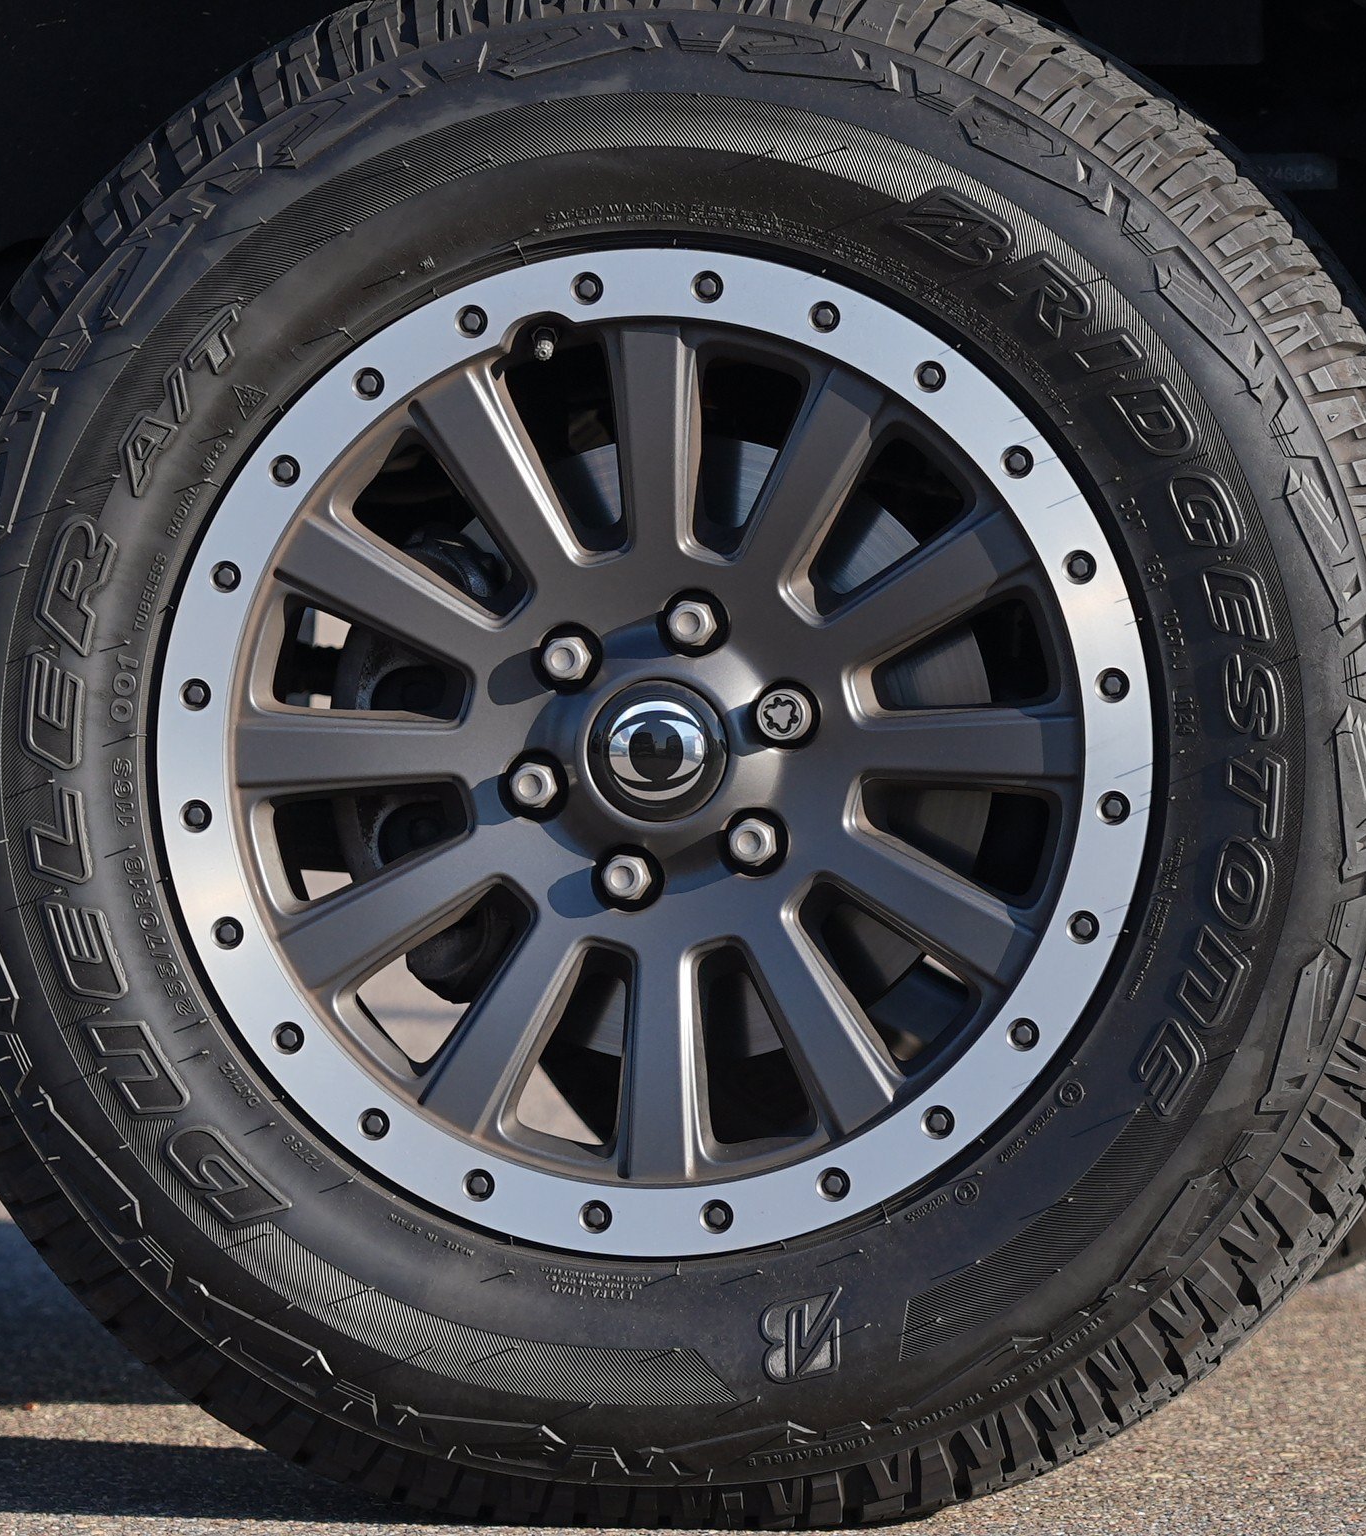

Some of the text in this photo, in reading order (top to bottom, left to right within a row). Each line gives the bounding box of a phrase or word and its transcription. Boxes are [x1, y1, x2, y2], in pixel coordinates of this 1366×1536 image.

[163, 481, 202, 538] RADIAL
[131, 550, 169, 632] TUBELESS
[889, 186, 1289, 1121] BRIDGESTONE
[109, 652, 141, 723] 001
[21, 302, 292, 1229] DUELER A/T
[111, 757, 137, 828] 116S
[122, 853, 197, 1019] 255/70R18
[384, 1210, 475, 1258] MADE IN SPAIN
[1020, 1313, 1105, 1376] TREADWEAR
[907, 1389, 984, 1431] TRACTION
[988, 1371, 1019, 1395] 300
[762, 1433, 875, 1467] TEMPERATURE
